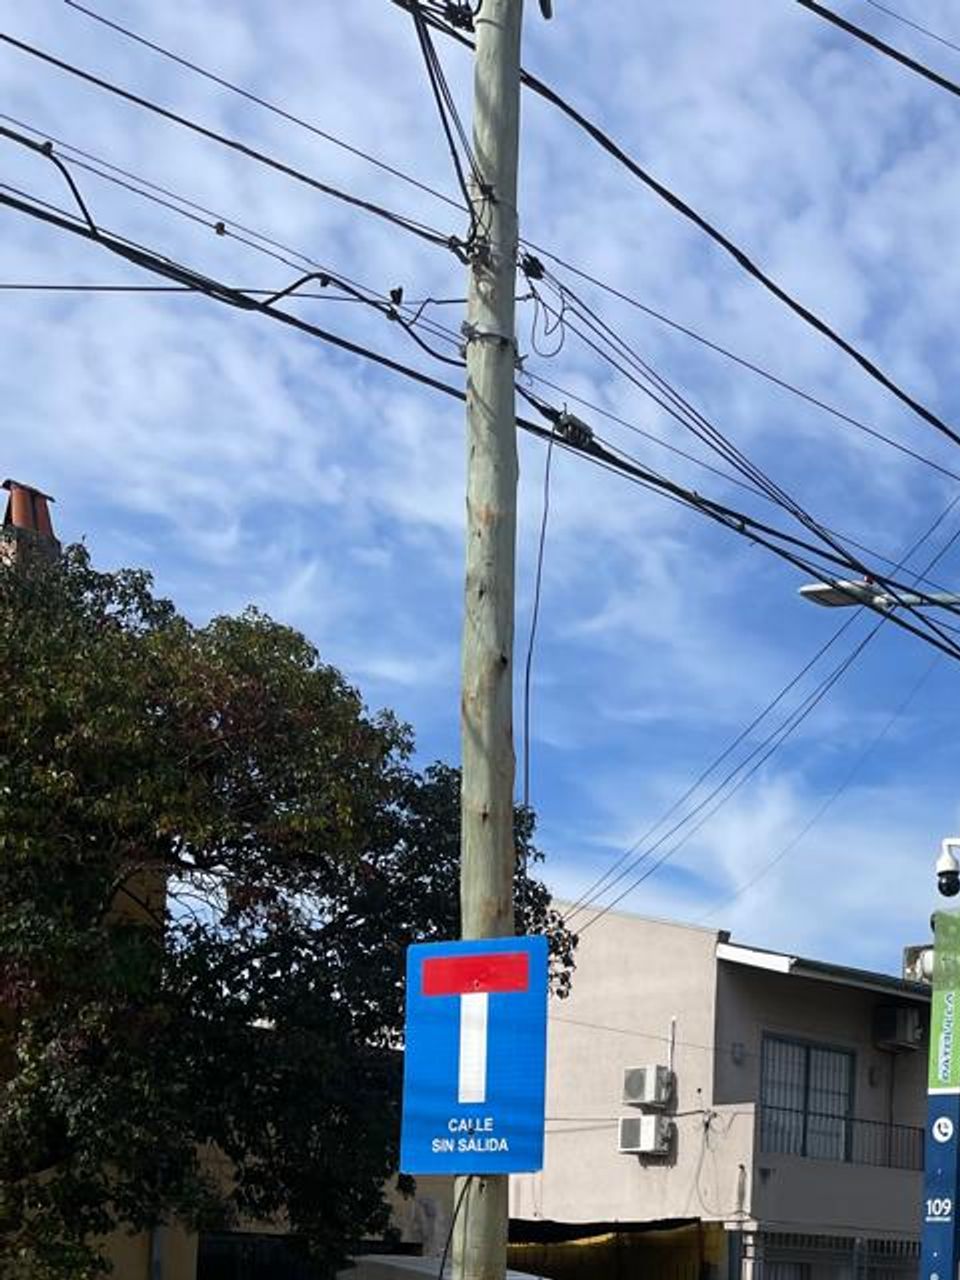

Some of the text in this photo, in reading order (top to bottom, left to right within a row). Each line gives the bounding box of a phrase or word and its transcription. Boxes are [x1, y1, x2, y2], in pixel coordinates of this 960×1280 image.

[448, 1118, 493, 1132] CALLE
[431, 1138, 509, 1153] SIN SALIDA
[926, 1198, 952, 1216] 109
